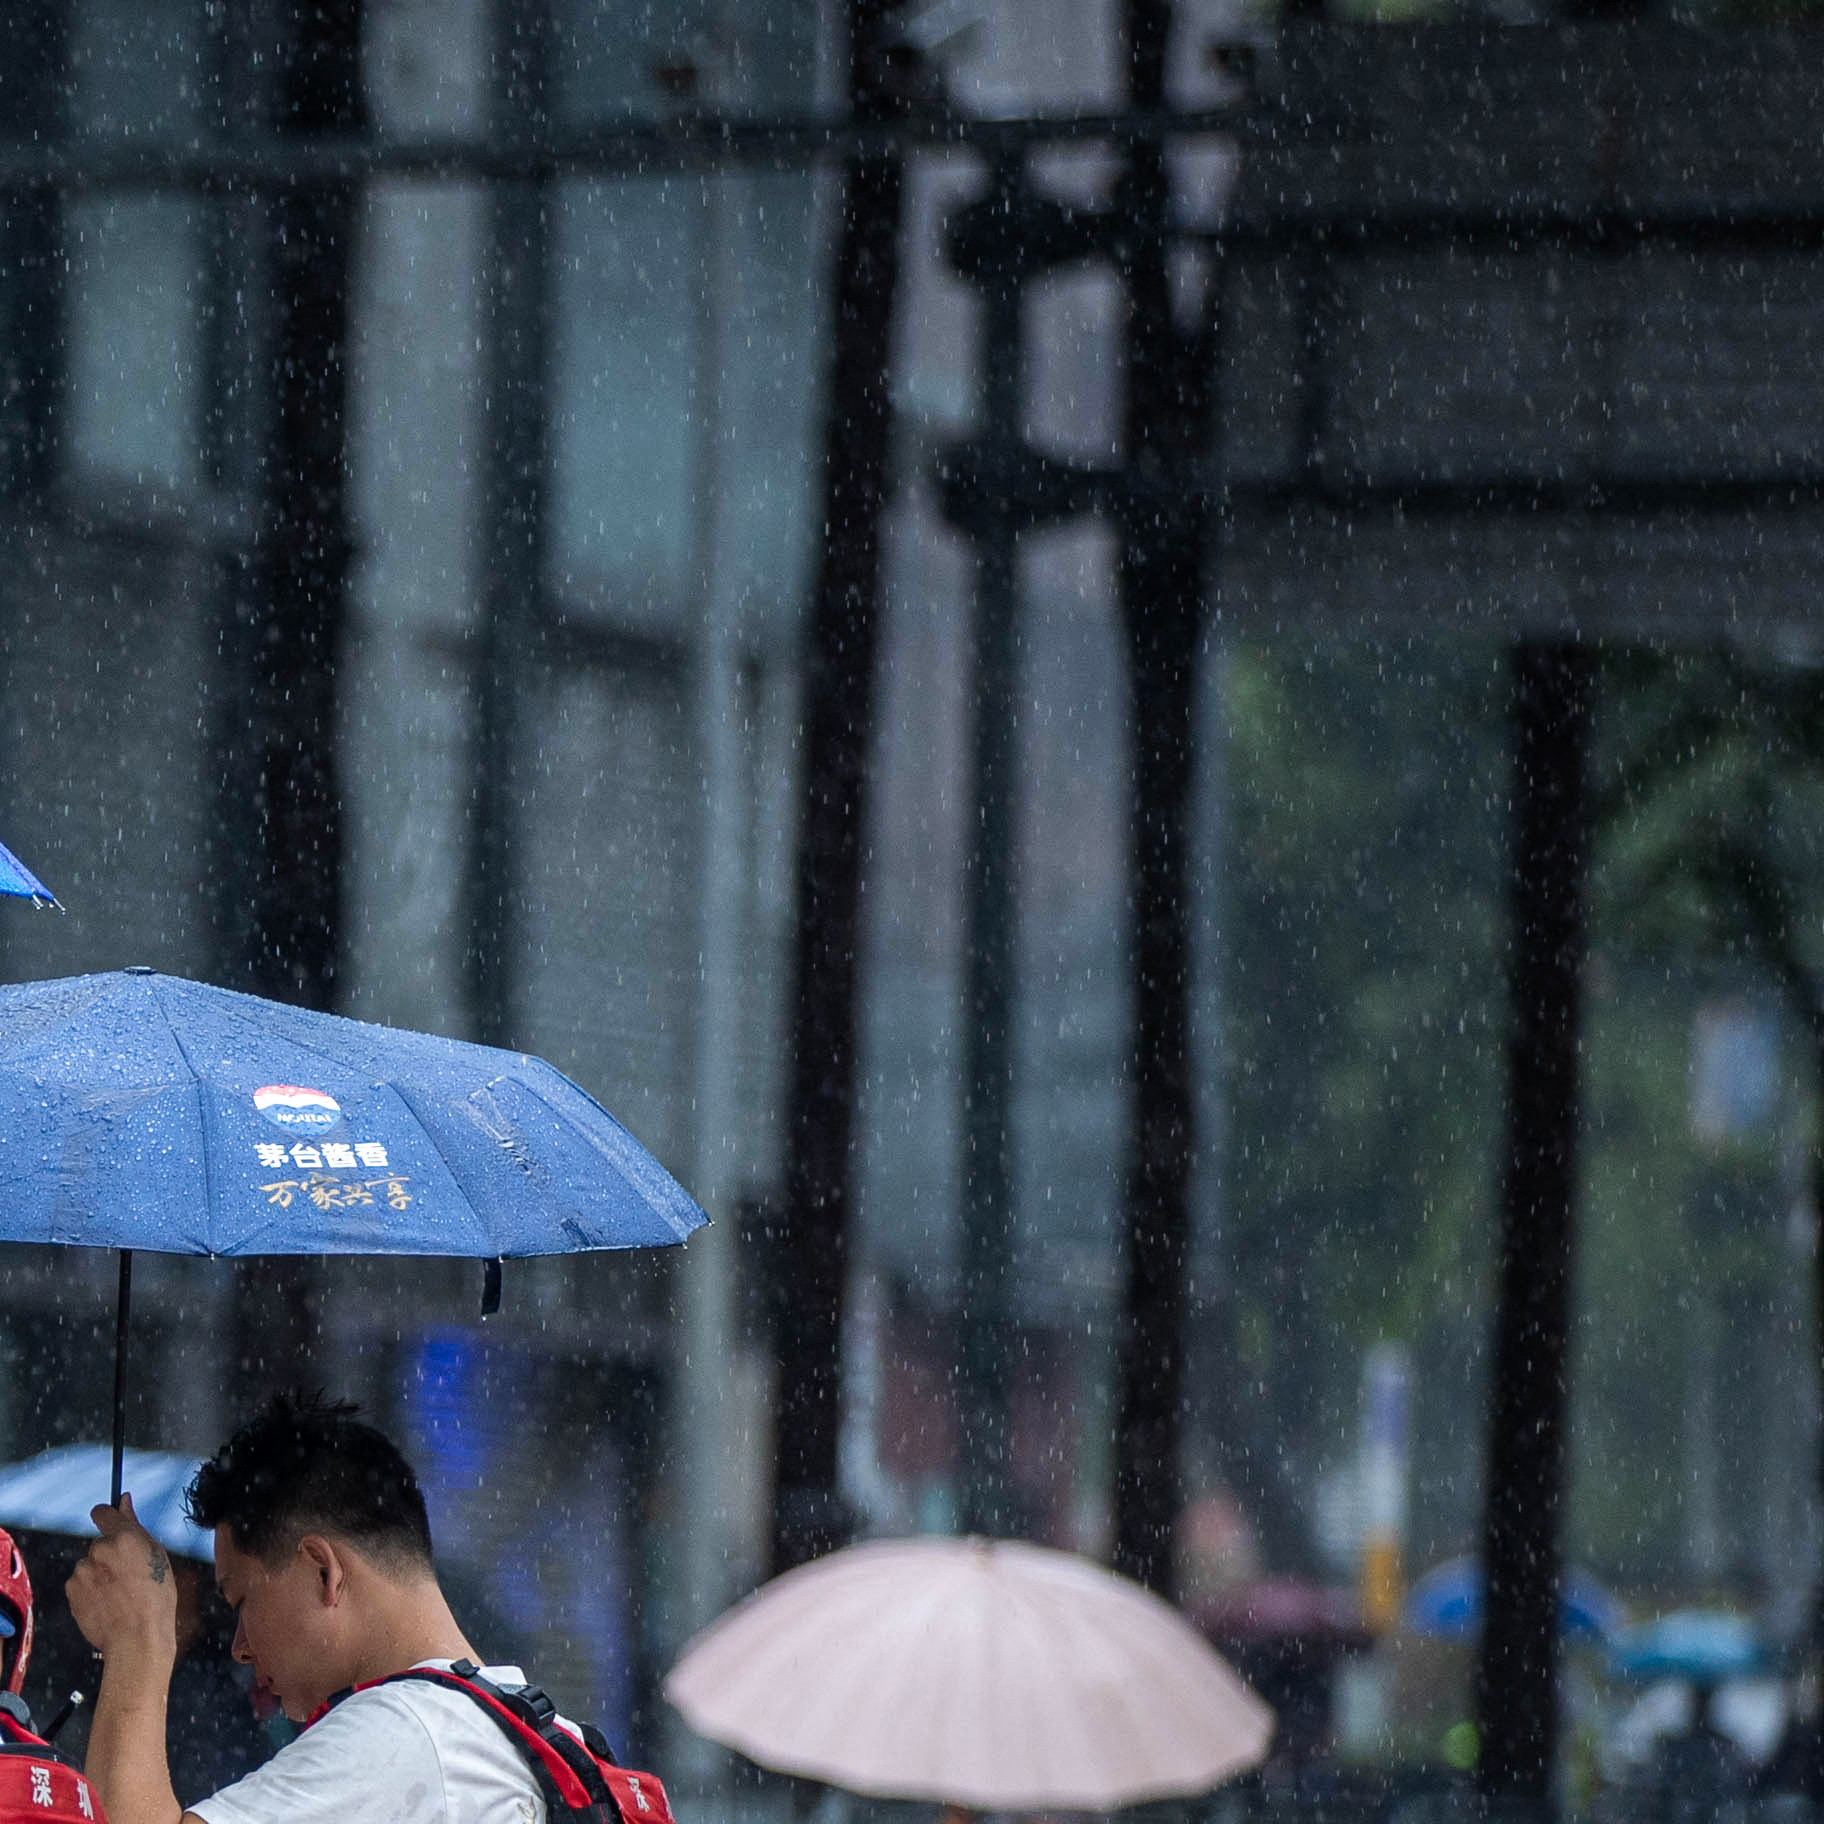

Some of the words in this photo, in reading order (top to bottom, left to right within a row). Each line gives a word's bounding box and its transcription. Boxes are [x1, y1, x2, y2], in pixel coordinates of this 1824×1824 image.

[253, 1142, 389, 1168] 茅台酱香
[30, 1766, 94, 1821] 深圳
